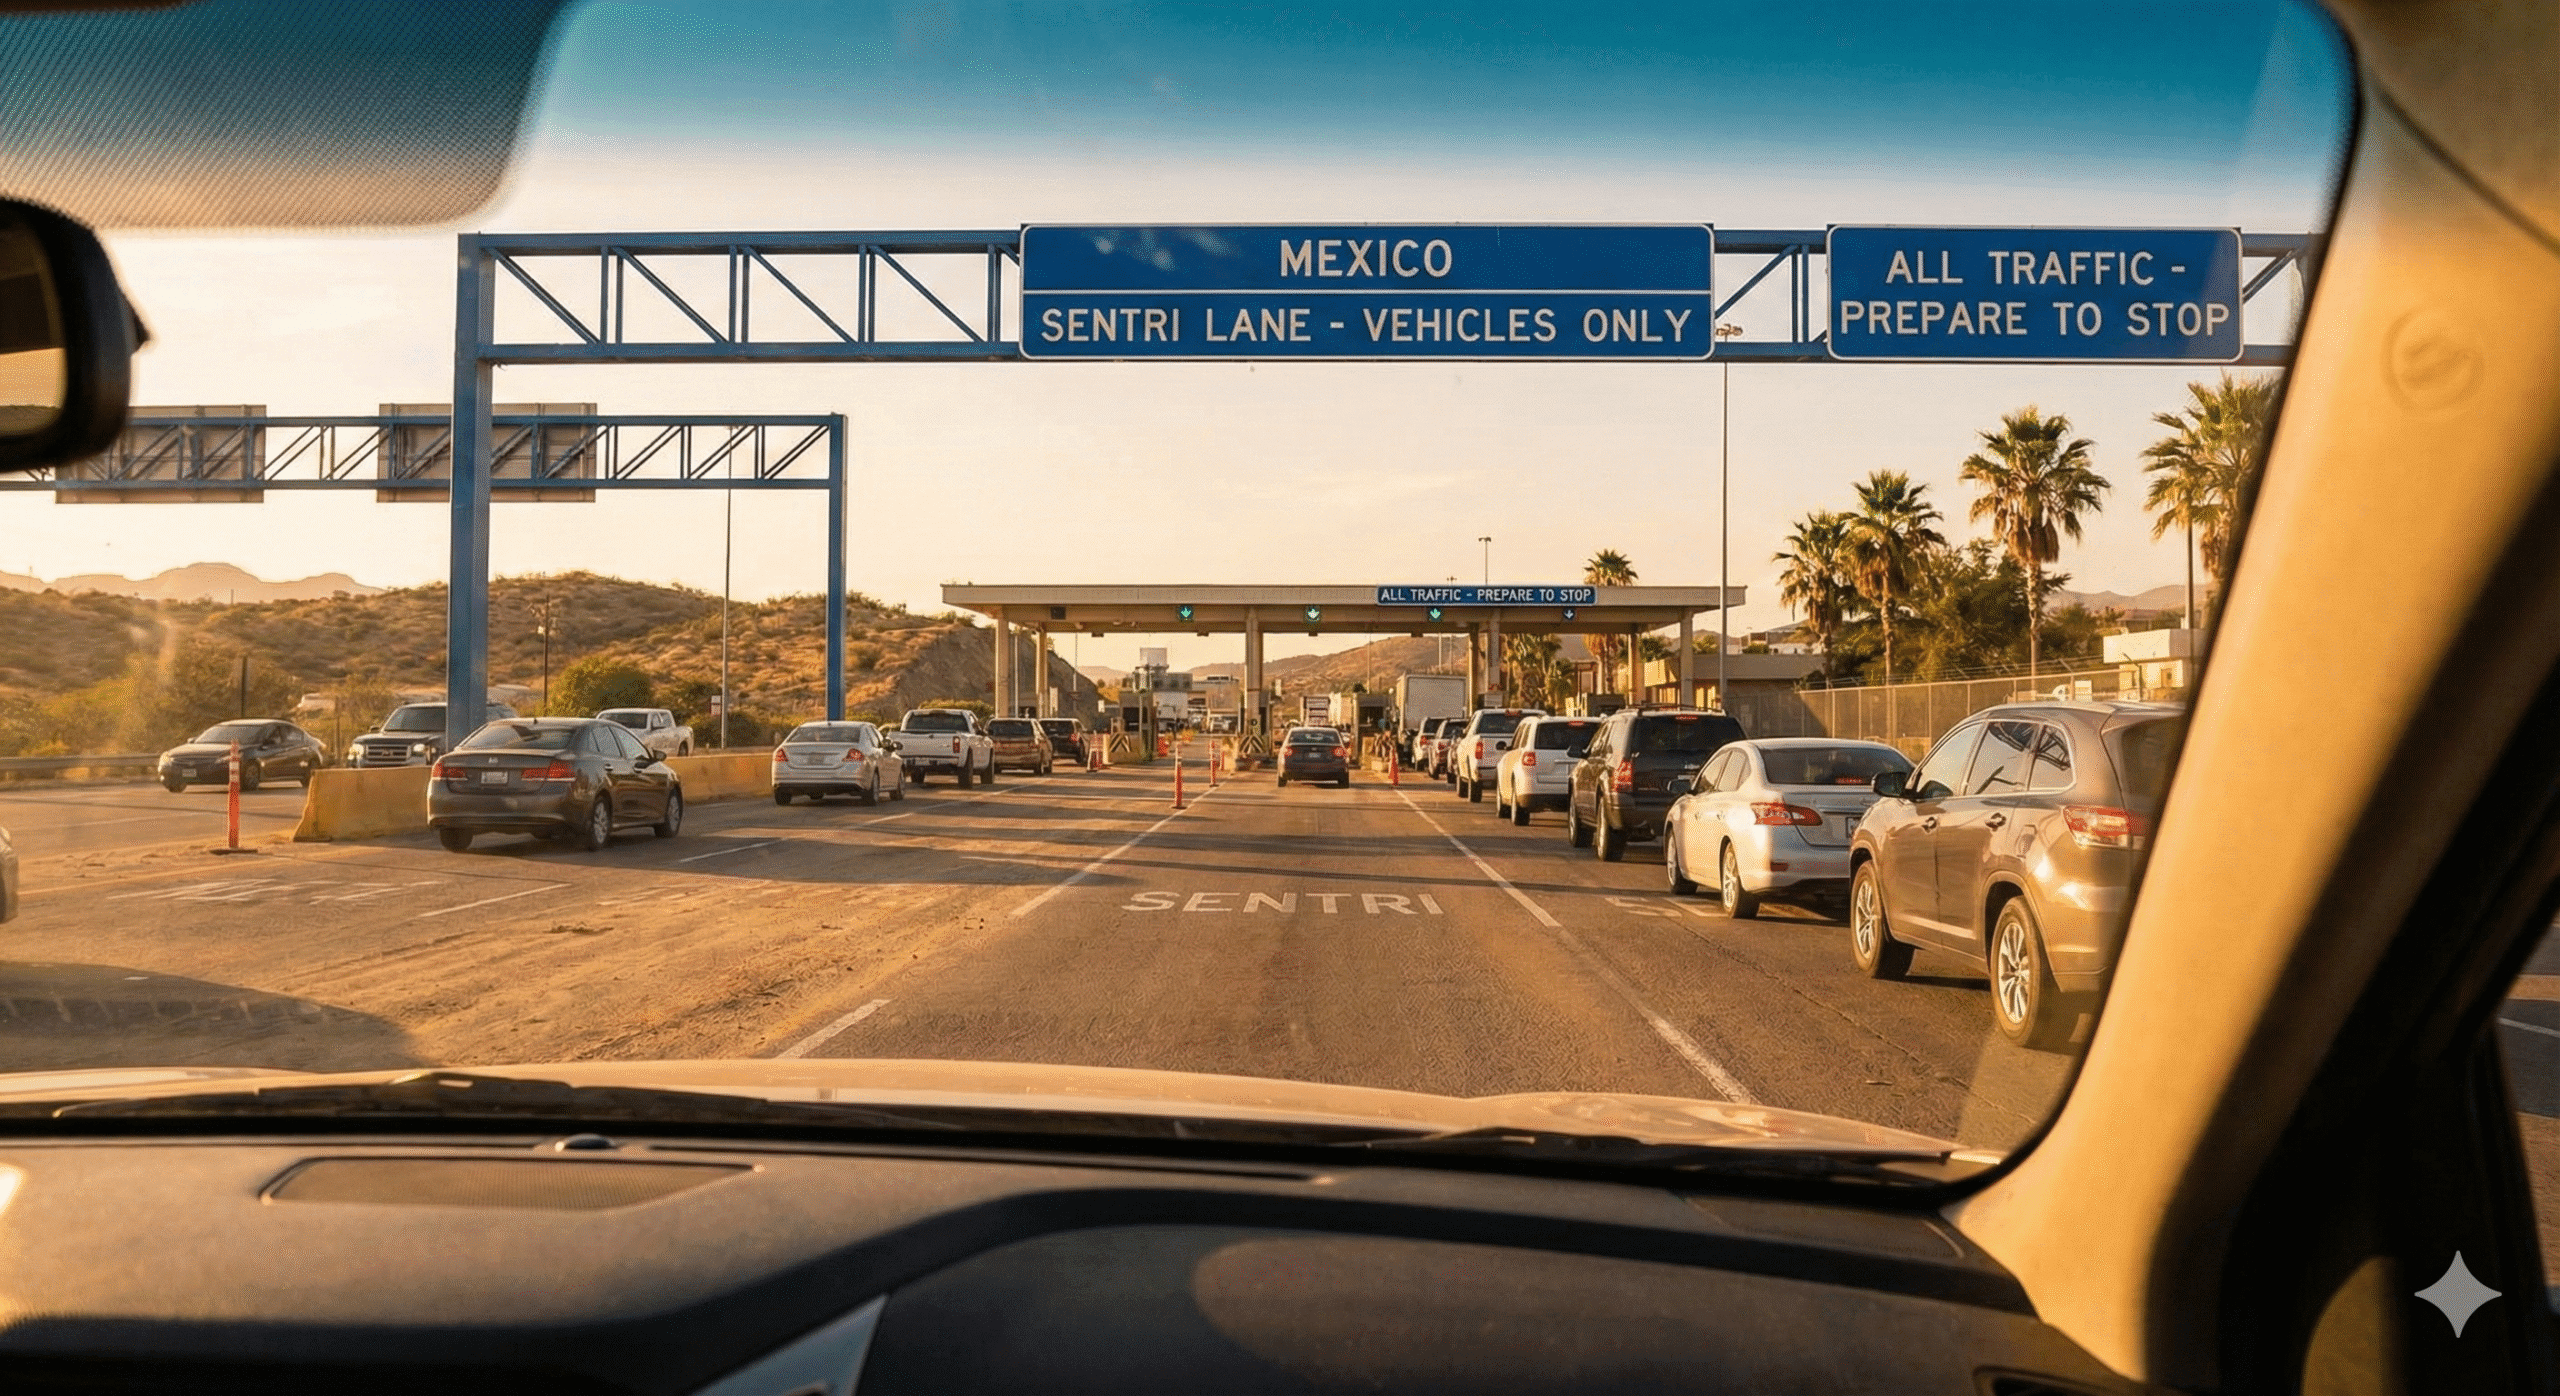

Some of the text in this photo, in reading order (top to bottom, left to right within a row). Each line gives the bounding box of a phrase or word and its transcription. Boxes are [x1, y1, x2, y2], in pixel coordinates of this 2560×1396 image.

[1280, 239, 1453, 278] MEXICO
[1885, 250, 1964, 284] ALL
[1987, 250, 2154, 285] TRAFFIC
[1041, 308, 1179, 342] SENTRI
[1206, 308, 1312, 342] LANE
[1362, 307, 1557, 343] VEHICLES
[1583, 308, 1692, 343] ONLY
[1840, 300, 2231, 337] PREPARE TO STOP
[1380, 588, 1406, 601] ALL
[1411, 588, 1462, 601] TRAFFIC
[1477, 588, 1534, 602] PREPARE
[1539, 588, 1555, 602] TO
[1560, 588, 1592, 602] STOP
[1121, 891, 1445, 915] SENTRI
